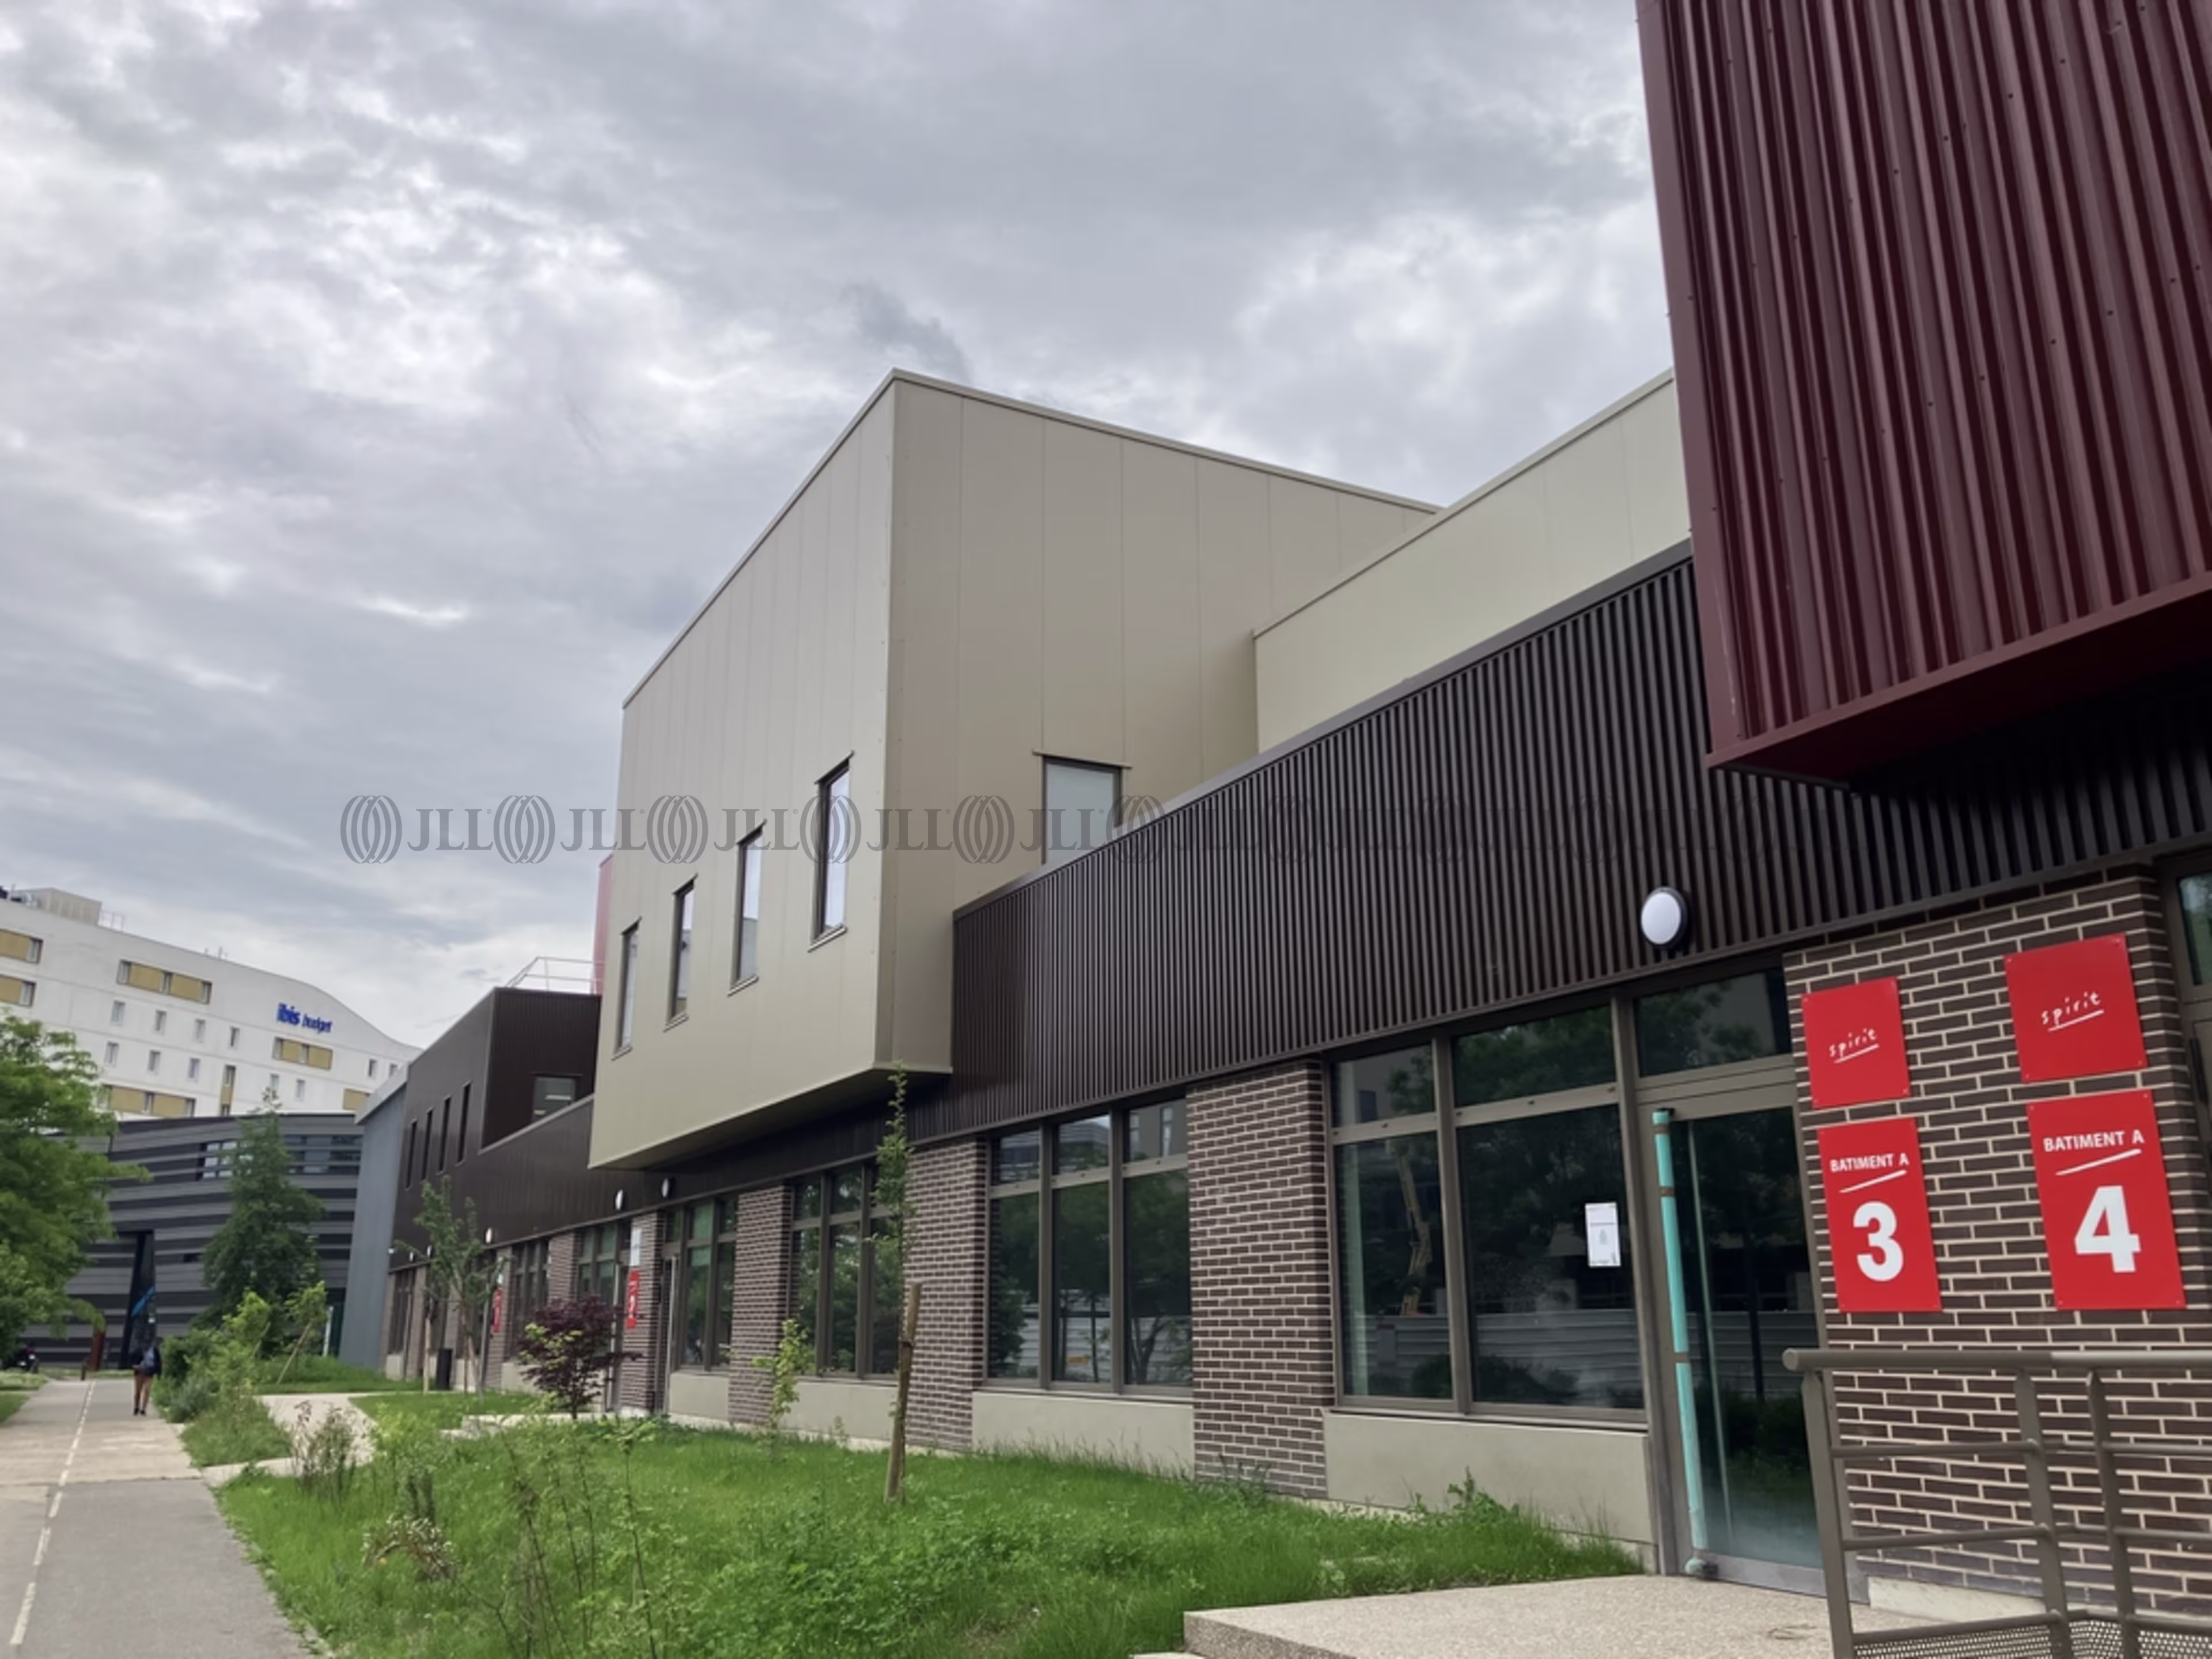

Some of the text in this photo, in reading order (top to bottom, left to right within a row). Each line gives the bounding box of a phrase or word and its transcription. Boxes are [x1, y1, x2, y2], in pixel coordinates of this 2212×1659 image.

[278, 1002, 332, 1034] ibis budget
[2041, 991, 2101, 1027] spirit
[1829, 1028, 1877, 1060] spirit
[2043, 1129, 2145, 1152] BATIMENT A
[1830, 1152, 1910, 1172] BATIMENT A
[1853, 1202, 1903, 1281] 3
[2075, 1185, 2141, 1273] 4
